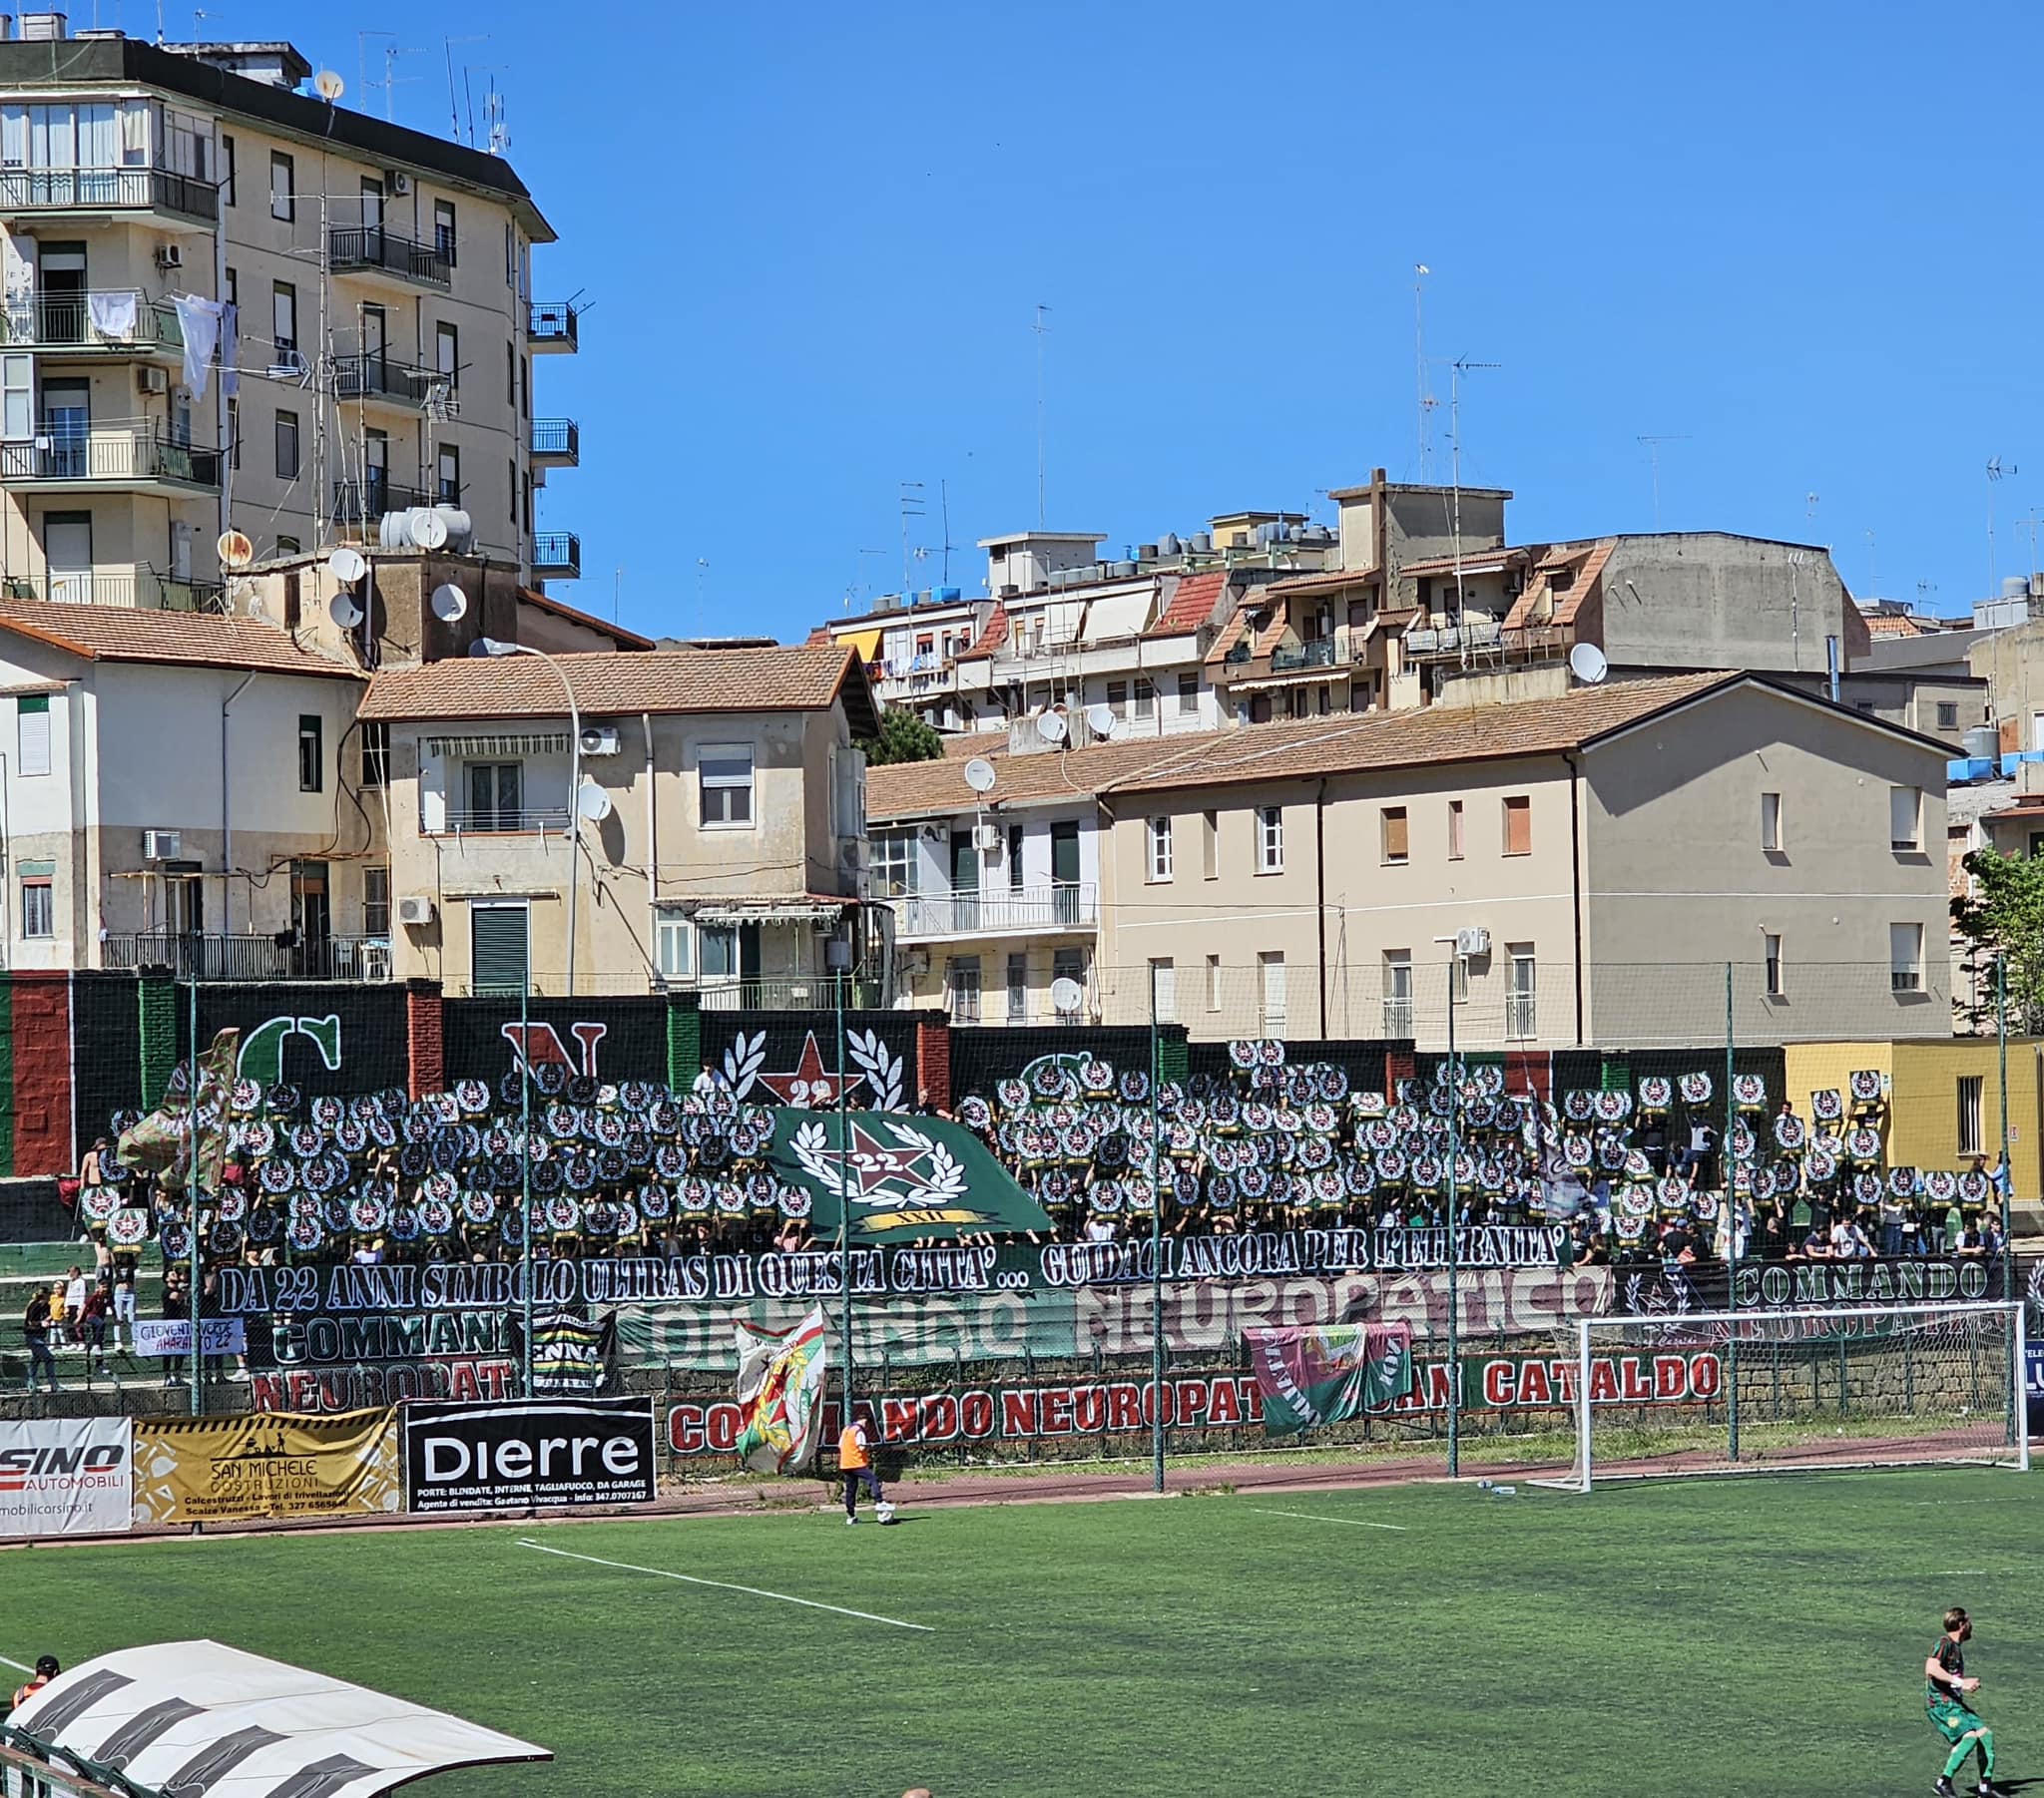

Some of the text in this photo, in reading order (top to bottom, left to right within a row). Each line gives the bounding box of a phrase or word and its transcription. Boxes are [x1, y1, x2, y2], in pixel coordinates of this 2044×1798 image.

[851, 1153, 904, 1172] 22
[896, 1210, 947, 1223] XXII
[221, 1268, 269, 1312] DA
[275, 1266, 318, 1311] 22
[326, 1264, 415, 1310] ANNI
[421, 1259, 577, 1307] SIMBOLO
[581, 1255, 709, 1303] ULTRAS
[714, 1254, 755, 1297] DI
[759, 1249, 886, 1297] QUESTA
[1041, 1237, 1174, 1286] GUIDACI
[1178, 1231, 1300, 1277] ANCORA
[1303, 1228, 1370, 1270] PER
[1736, 1262, 1988, 1306] COMMANDO
[1364, 1362, 1462, 1414] AN
[1483, 1352, 1722, 1406] CATALDO
[211, 1460, 318, 1480] SAN MICHELE
[25, 1476, 124, 1492] AUTOMOBILI
[211, 1478, 318, 1493] COSTRUZIONI
[417, 1488, 447, 1498] PORTE:
[534, 1482, 596, 1493] TAGLIAFUOCO,
[597, 1481, 610, 1490] DA
[611, 1479, 647, 1489] GARAGE
[284, 1492, 293, 1501] di
[449, 1499, 457, 1508] di
[530, 1494, 568, 1505] Vivacqua
[269, 1502, 285, 1512] Tel.
[288, 1501, 305, 1510] 327
